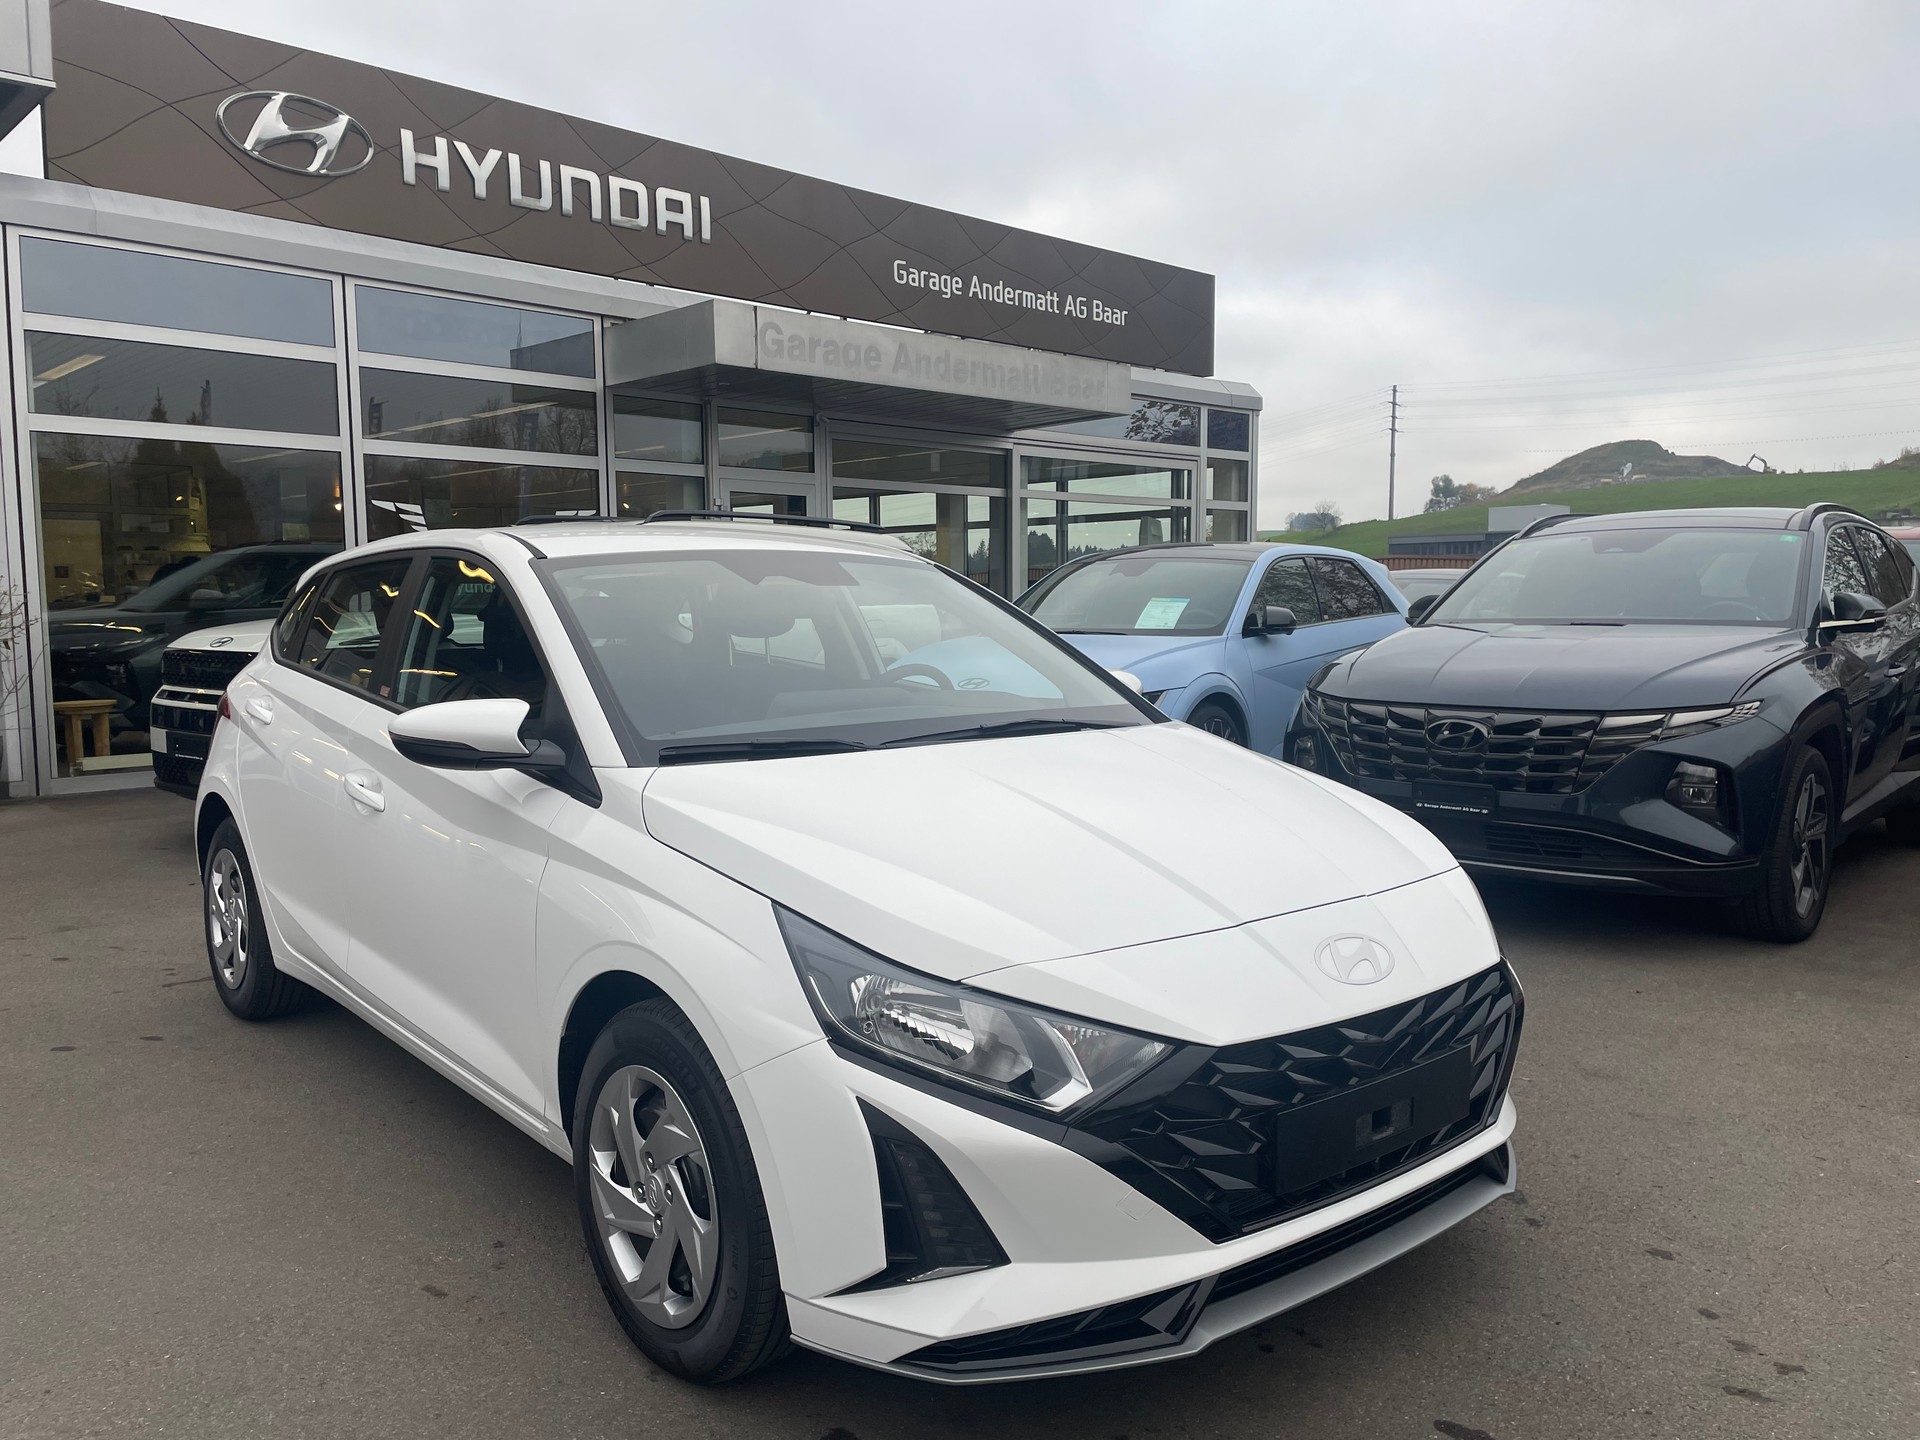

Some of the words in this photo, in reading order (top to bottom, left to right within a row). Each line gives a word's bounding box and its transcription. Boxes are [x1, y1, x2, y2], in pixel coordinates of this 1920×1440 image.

[400, 127, 711, 244] HYUNDAI
[892, 259, 963, 299] Garage
[968, 275, 1060, 314] Andermatt
[1064, 294, 1088, 319] AG
[1092, 299, 1129, 326] Baar
[758, 321, 883, 372] Garage
[891, 340, 1042, 394] Andermatt
